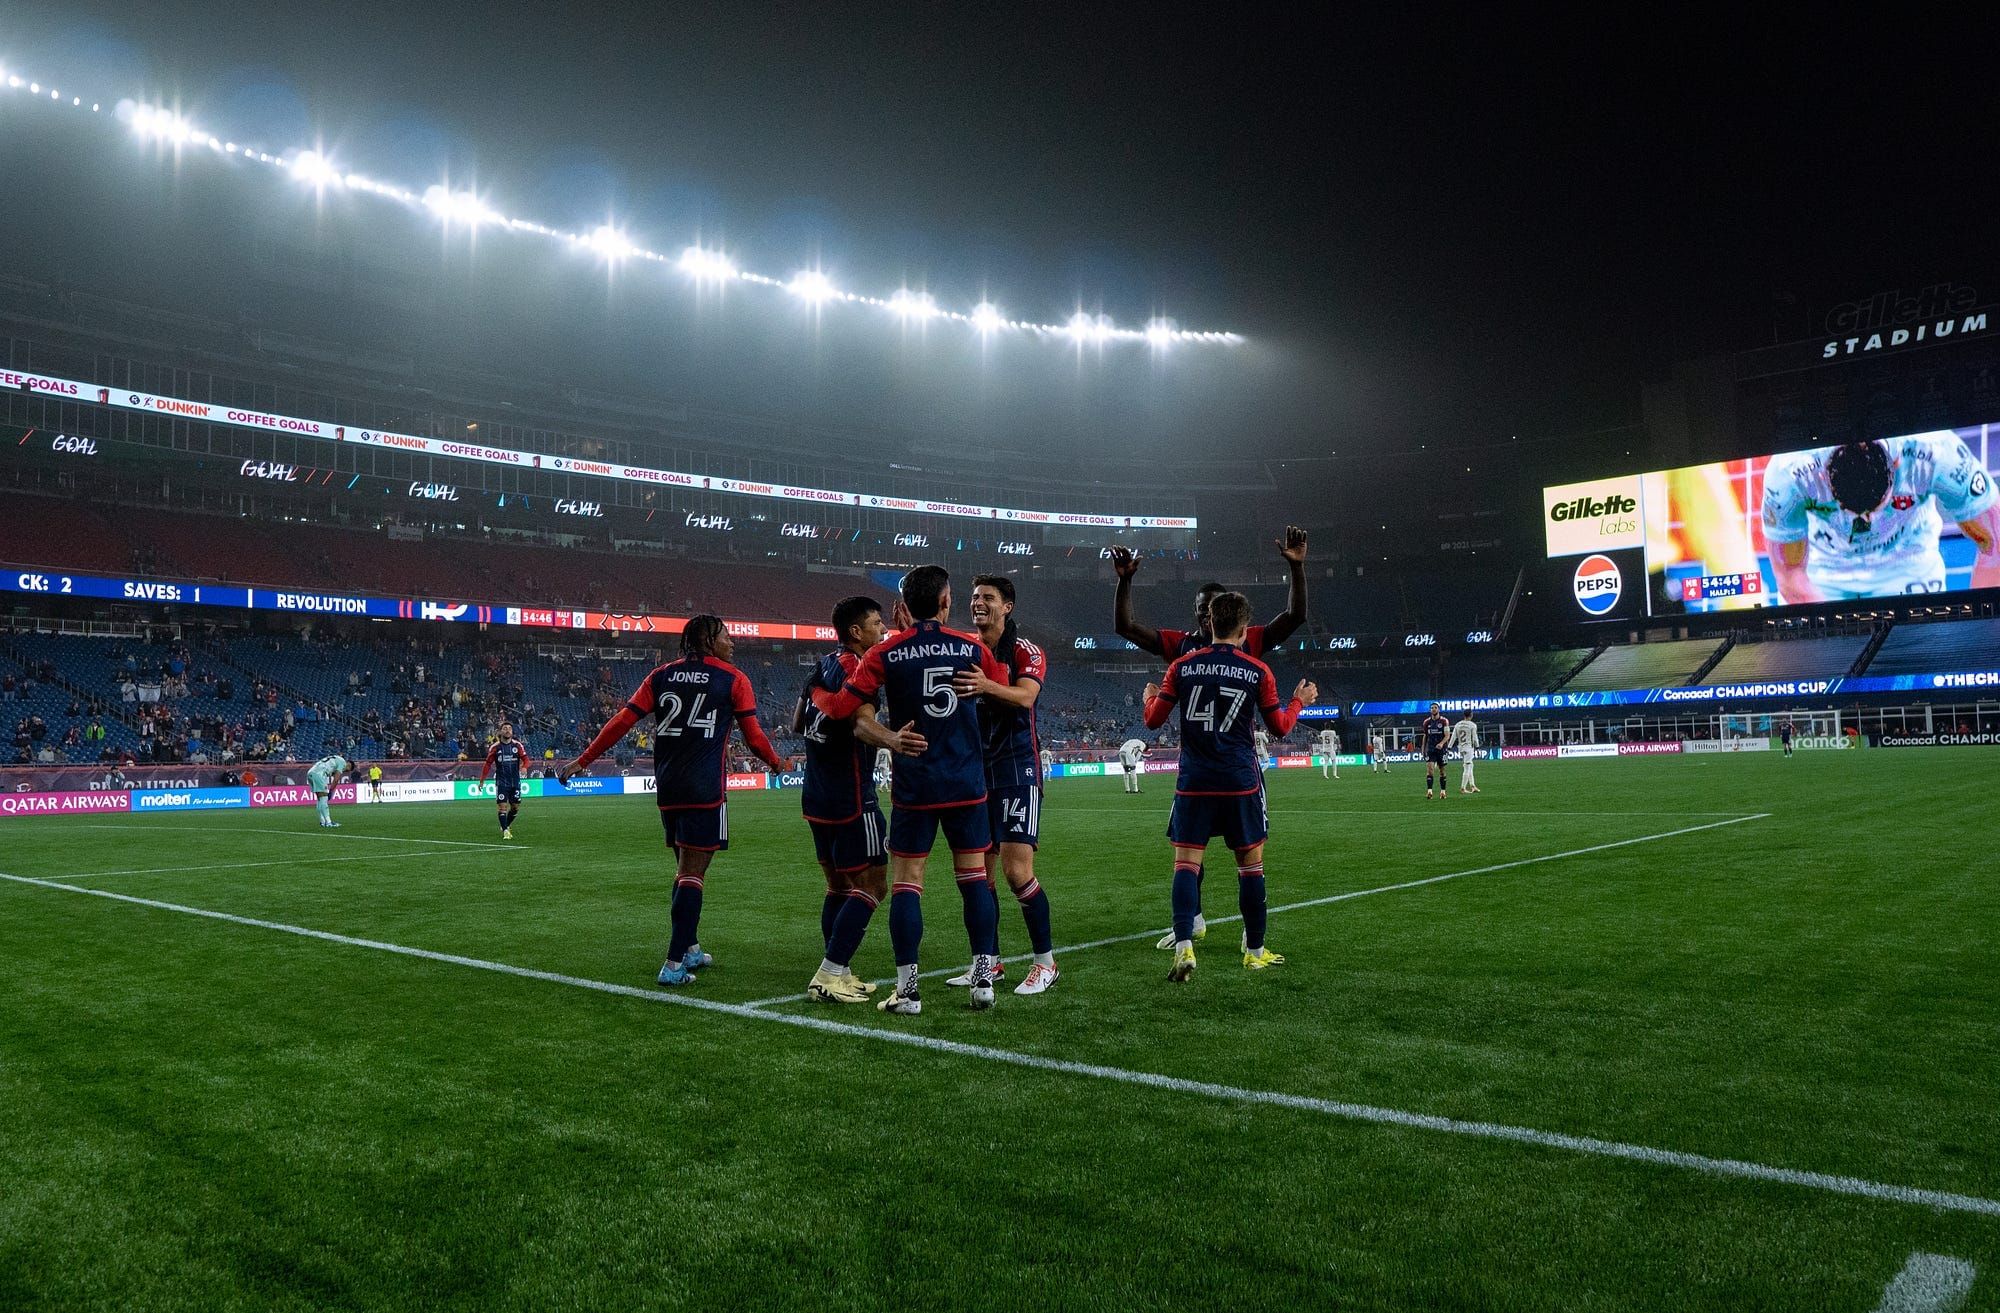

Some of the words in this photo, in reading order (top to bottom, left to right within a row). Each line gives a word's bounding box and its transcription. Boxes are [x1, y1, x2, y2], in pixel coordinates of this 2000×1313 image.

[1822, 313, 1987, 358] STADIUM
[27, 377, 78, 395] GOALS
[156, 399, 210, 417] DUNKIN'
[227, 411, 276, 427] COFFEE
[279, 420, 320, 434] GOALS
[383, 434, 428, 449] DUNKIN'
[442, 443, 483, 457] COFFEE
[485, 449, 520, 463] GOALS
[573, 461, 613, 474] DUNKIN'
[623, 468, 659, 481] COFFEE
[661, 474, 692, 484] GOALS
[738, 483, 773, 494] DUNKIN'
[783, 488, 815, 499] COFFEE
[817, 491, 844, 502] GOALS
[886, 499, 918, 510] DUNKIN'
[926, 503, 956, 514] COFFEE
[957, 505, 982, 516] GOALS
[1550, 494, 1636, 522] Gillette
[1020, 512, 1050, 522] DUNKIN'
[1058, 514, 1088, 524] COFFEE
[1089, 516, 1114, 525] GOALS
[1600, 517, 1636, 535] Labs
[18, 574, 49, 591] CK:
[61, 577, 72, 593] 2
[1577, 577, 1618, 592] PEPSI
[1702, 575, 1740, 588] 54:46
[1748, 582, 1757, 592] 0
[124, 582, 181, 601] SAVES:
[194, 587, 200, 602] 1
[1688, 588, 1697, 598] 4
[277, 593, 367, 614] REVOLUTION
[523, 611, 553, 623] 54:46
[556, 611, 570, 619] HALF
[562, 618, 567, 626] 2
[887, 644, 975, 663] CHANCALAY
[668, 671, 710, 684] JONES
[1181, 663, 1259, 684] BAJRAKTAREVIC
[922, 666, 958, 718] 5
[1662, 687, 1714, 700] Concacaf
[1716, 683, 1795, 698] CHAMPIONS
[1798, 681, 1827, 693] CUP
[1186, 685, 1247, 733] 47
[1437, 697, 1534, 711] THECHAMPIONS
[657, 691, 718, 739] 24
[1882, 735, 1936, 746] Concacaf
[1503, 749, 1526, 758] QATAR
[1527, 748, 1557, 757] AIRWAYS
[1620, 746, 1645, 754] QATAR
[1647, 743, 1680, 752] AIRWAYS
[1070, 765, 1099, 775] aramco
[2, 797, 59, 813] QATAR
[61, 794, 128, 809] AIRWAYS
[140, 793, 191, 807] molten
[253, 789, 297, 805] QATAR
[1002, 797, 1027, 823] 14
